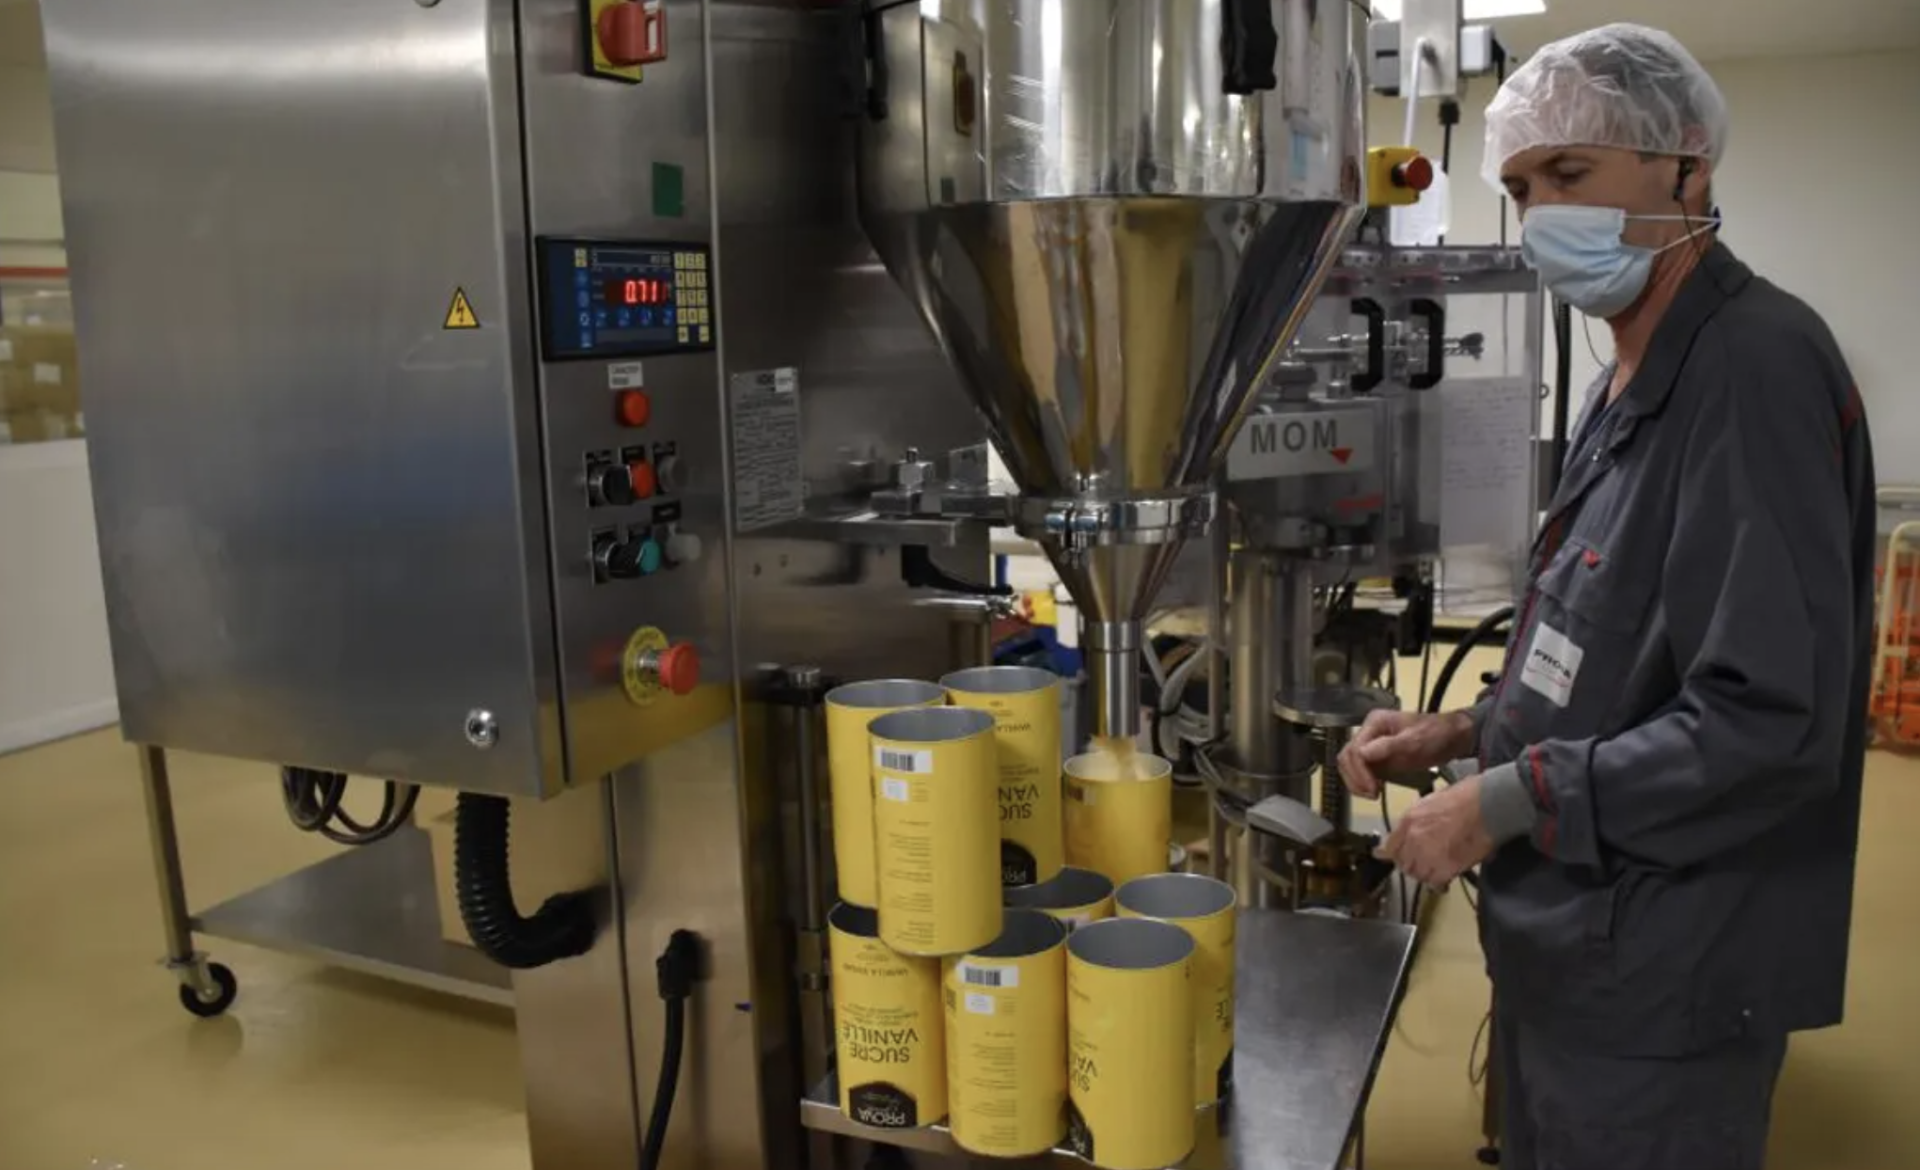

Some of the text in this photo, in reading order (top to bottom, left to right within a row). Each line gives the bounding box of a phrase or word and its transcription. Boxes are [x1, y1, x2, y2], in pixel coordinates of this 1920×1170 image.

[1251, 419, 1338, 455] MOM
[849, 1041, 910, 1064] SUCRE
[857, 1107, 906, 1126] PROVA
